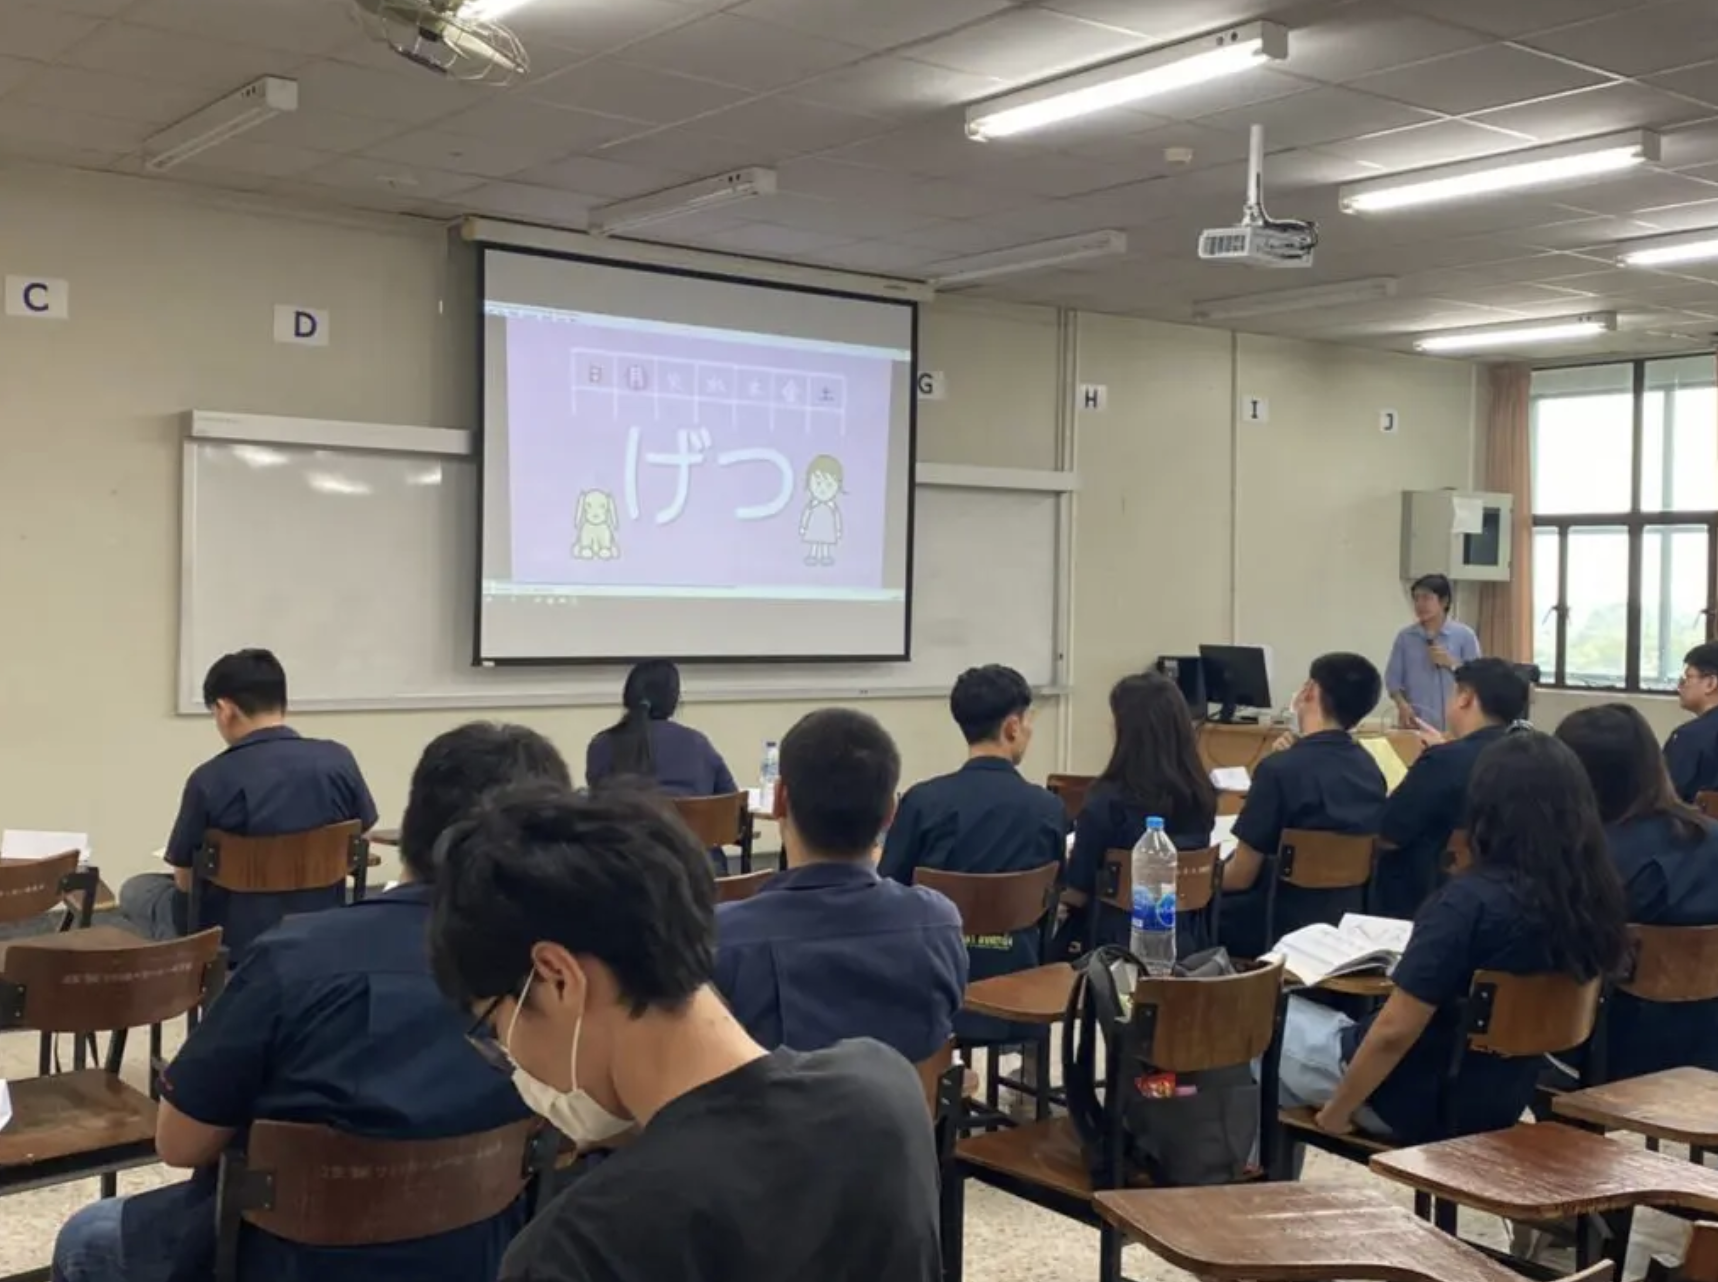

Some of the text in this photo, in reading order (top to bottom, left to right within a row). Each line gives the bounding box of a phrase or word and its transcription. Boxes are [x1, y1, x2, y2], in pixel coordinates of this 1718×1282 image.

[22, 283, 50, 312] C
[293, 310, 318, 338] D
[918, 372, 933, 395] G
[1084, 389, 1099, 409] H
[1250, 399, 1260, 420] I
[1383, 412, 1395, 432] J
[625, 426, 794, 525] げつ
